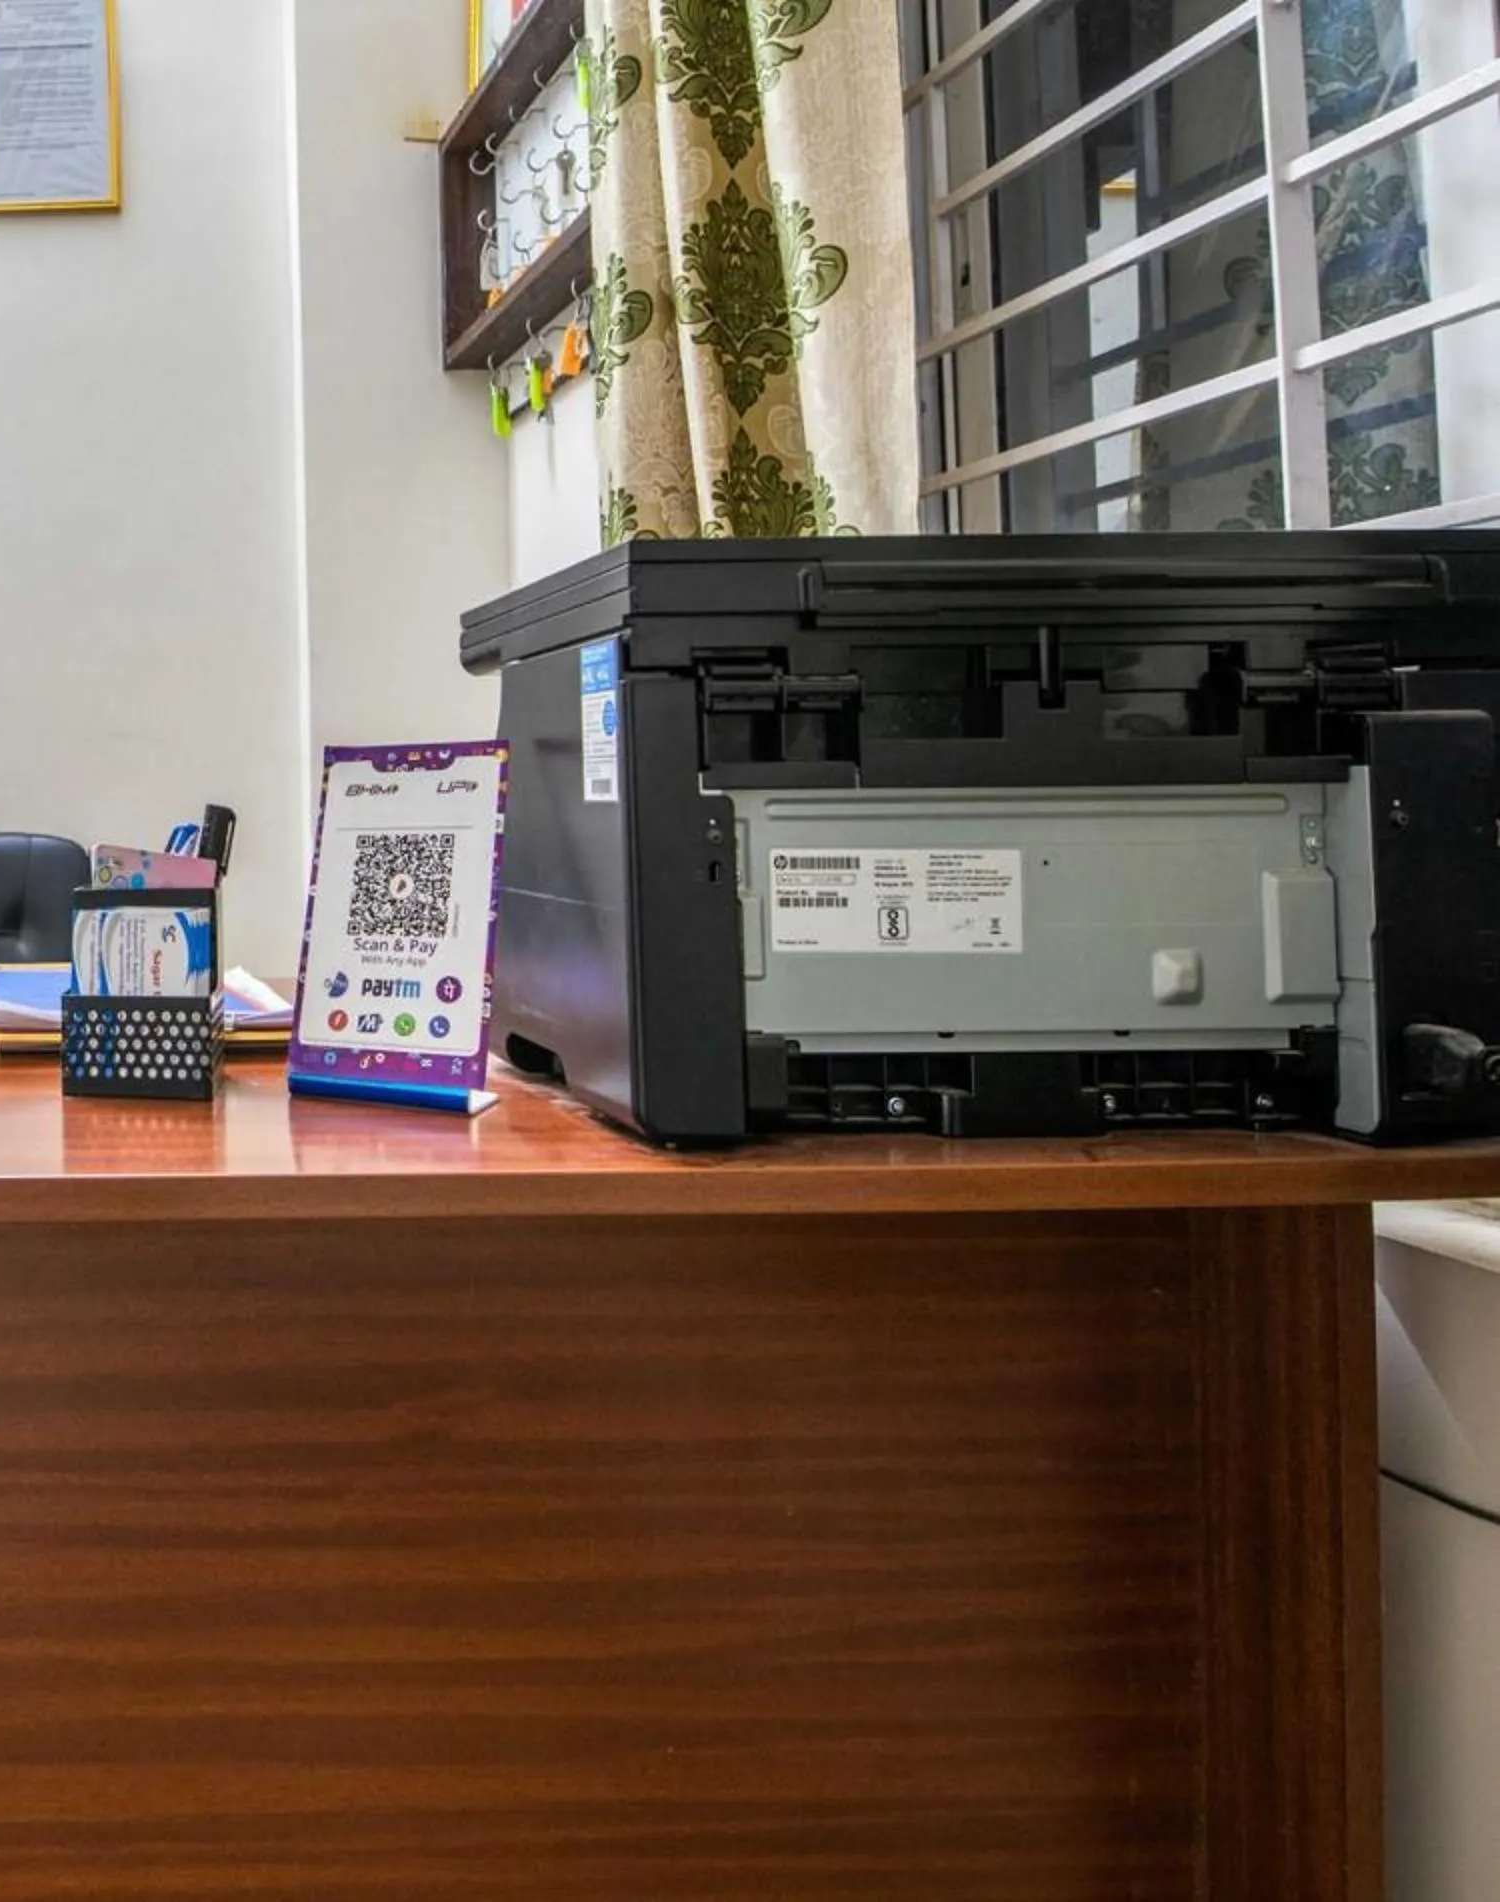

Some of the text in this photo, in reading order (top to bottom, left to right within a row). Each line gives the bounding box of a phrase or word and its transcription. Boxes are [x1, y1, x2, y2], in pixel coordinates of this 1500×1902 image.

[353, 938, 438, 957] Scan & Pay
[387, 956, 404, 967] Any
[407, 956, 427, 968] App
